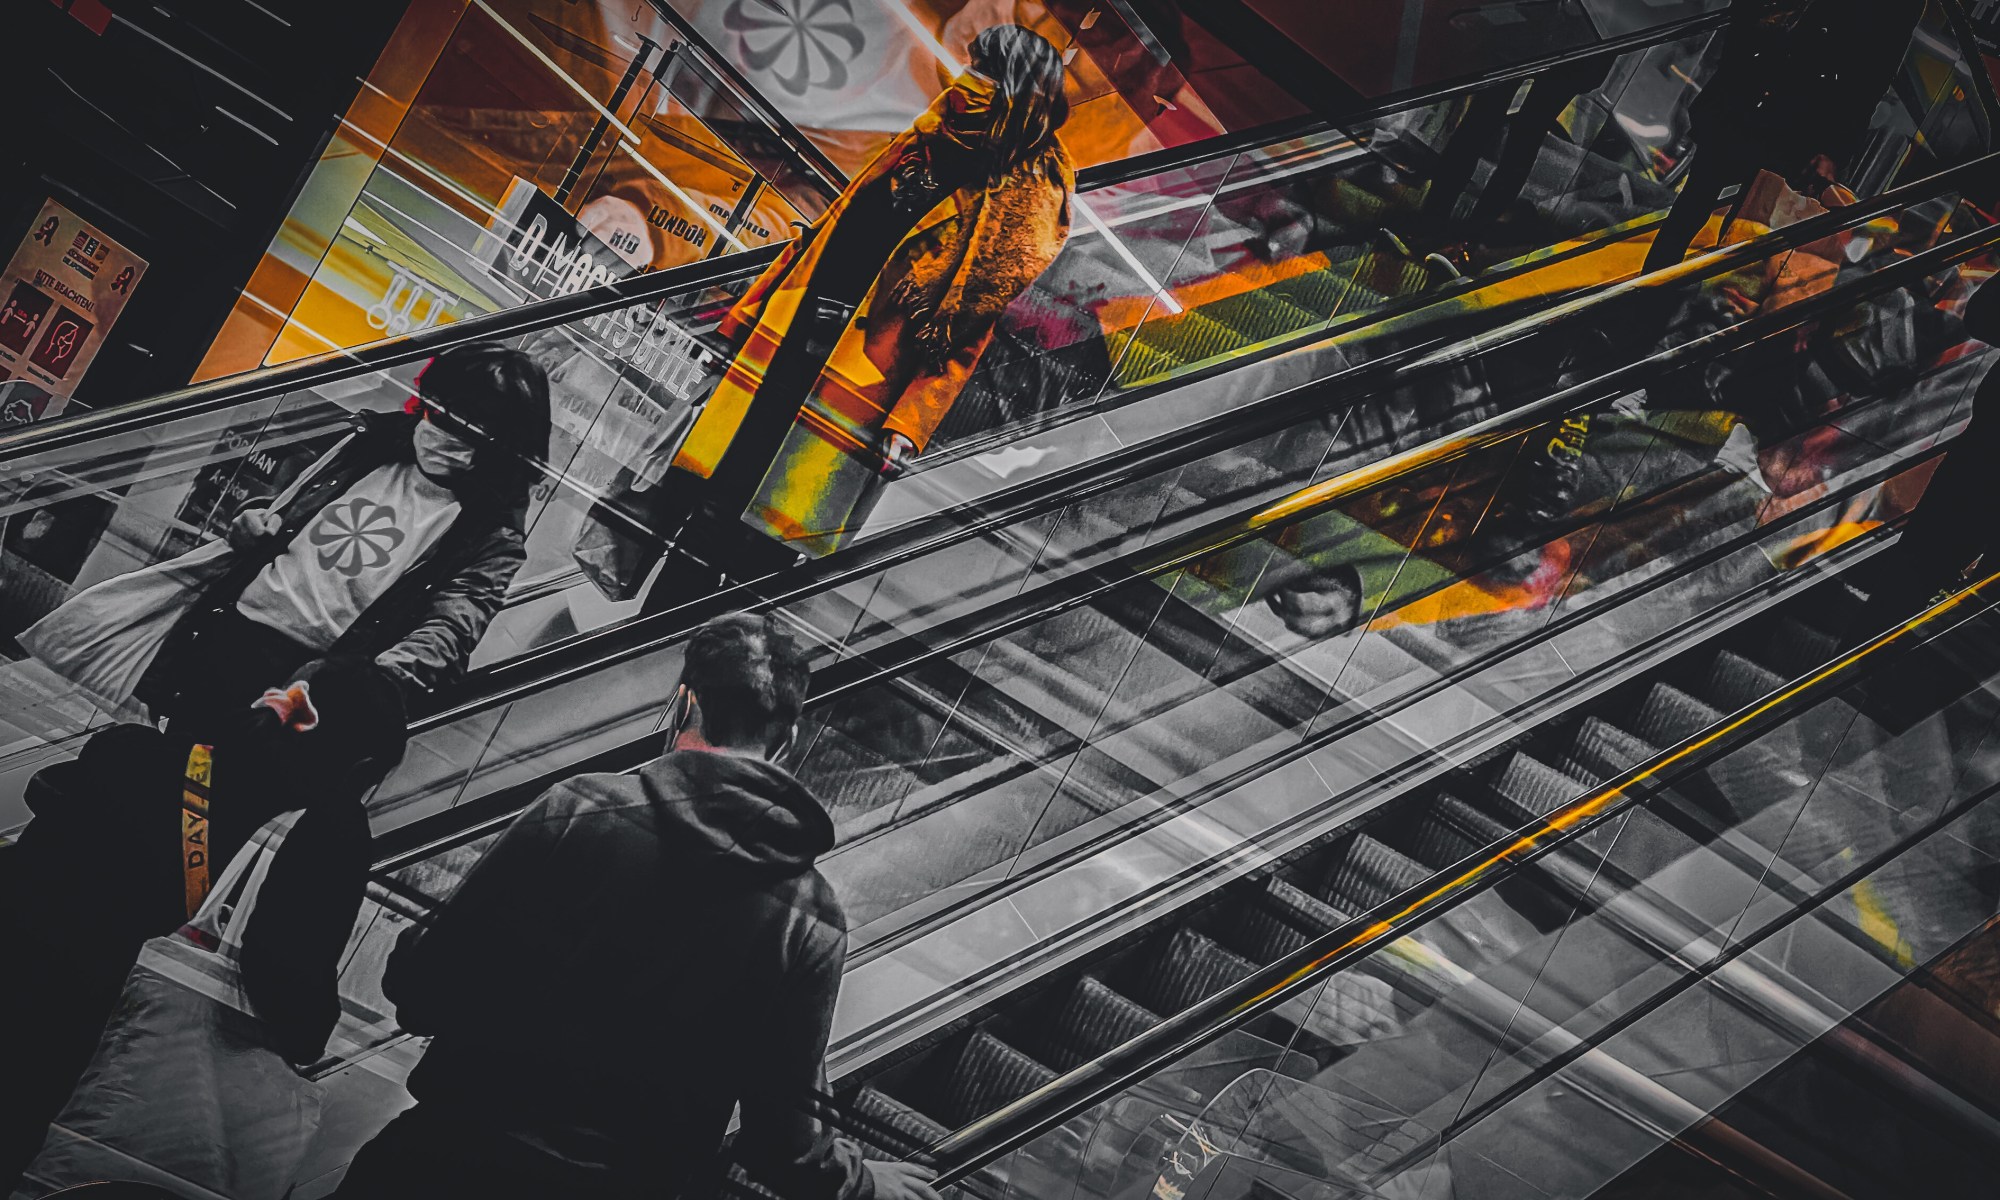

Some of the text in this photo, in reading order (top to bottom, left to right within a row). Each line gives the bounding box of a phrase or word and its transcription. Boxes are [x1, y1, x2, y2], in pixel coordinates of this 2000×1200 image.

[647, 204, 708, 248] LONDON
[35, 268, 56, 289] BITTE
[54, 281, 95, 312] BEACHTEN!
[633, 314, 713, 400] STYLE
[188, 812, 204, 869] DAY
